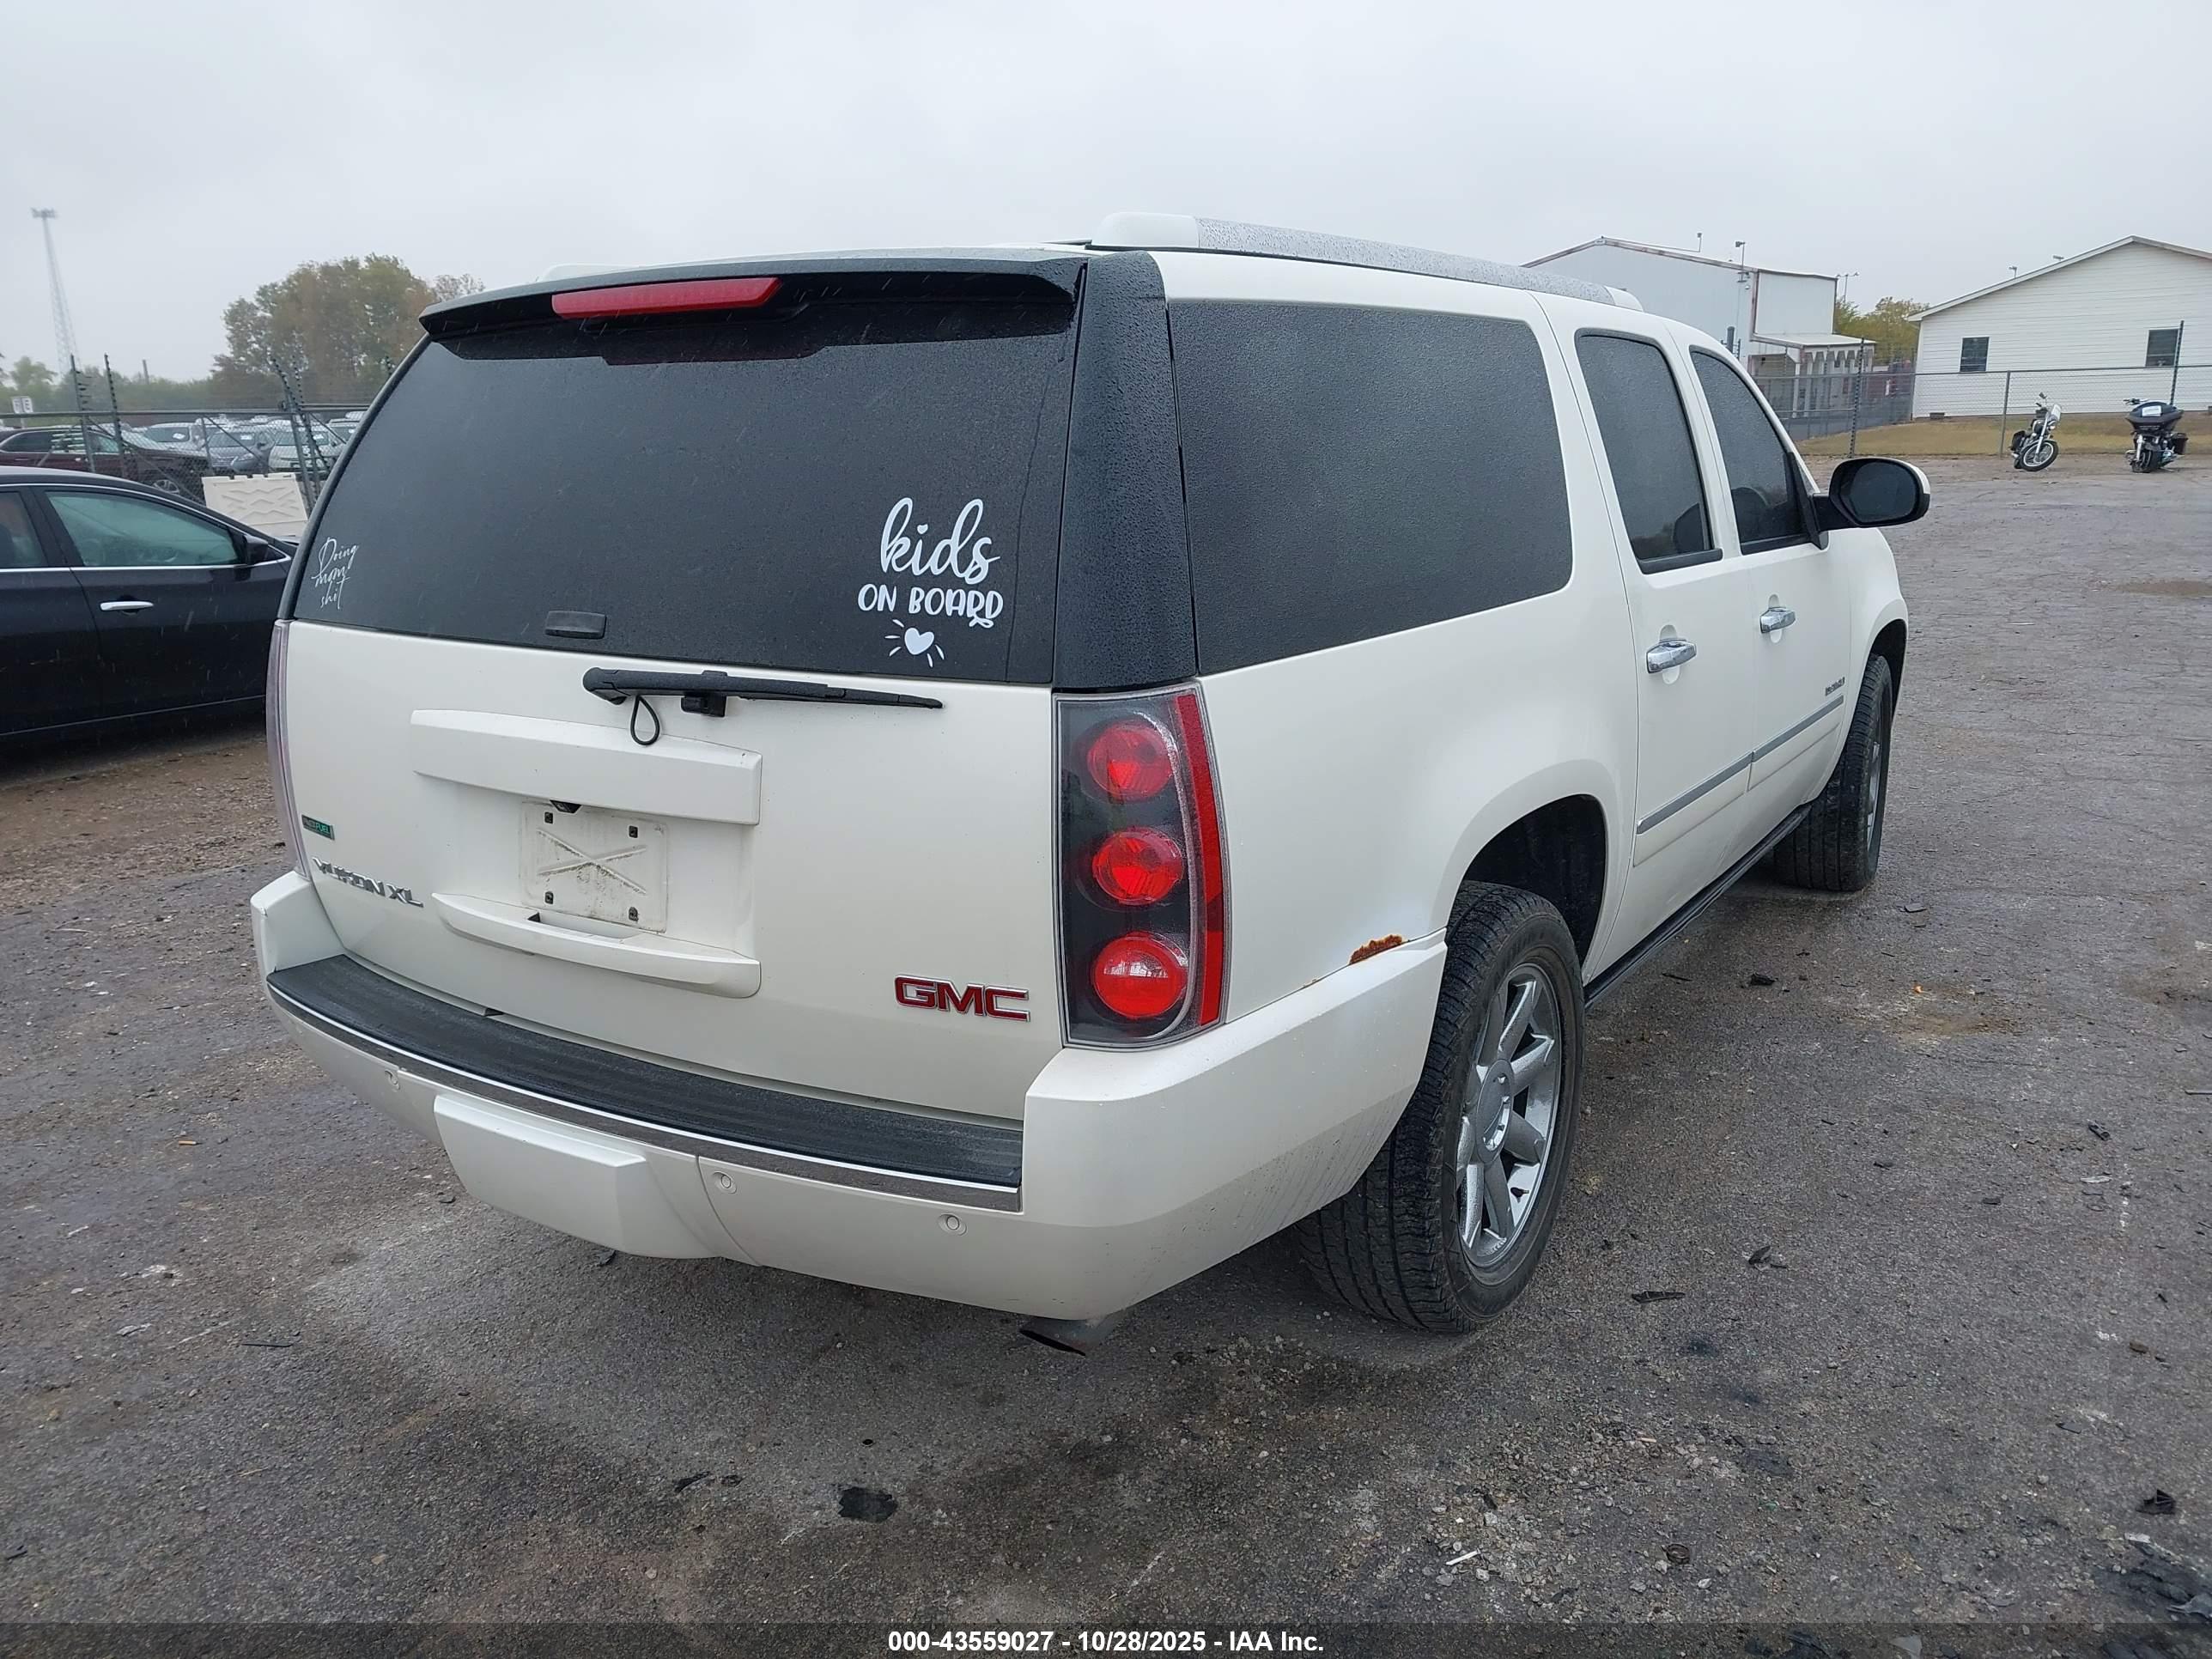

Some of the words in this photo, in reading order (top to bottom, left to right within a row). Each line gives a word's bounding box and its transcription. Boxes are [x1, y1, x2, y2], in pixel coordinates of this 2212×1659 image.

[311, 537, 359, 579] Doing
[880, 497, 1000, 585] kids
[314, 566, 346, 588] mom
[320, 576, 350, 611] shit
[857, 583, 897, 612] ON
[908, 586, 1004, 629] BOARD
[386, 883, 424, 908] XL
[894, 975, 1030, 1022] GMC
